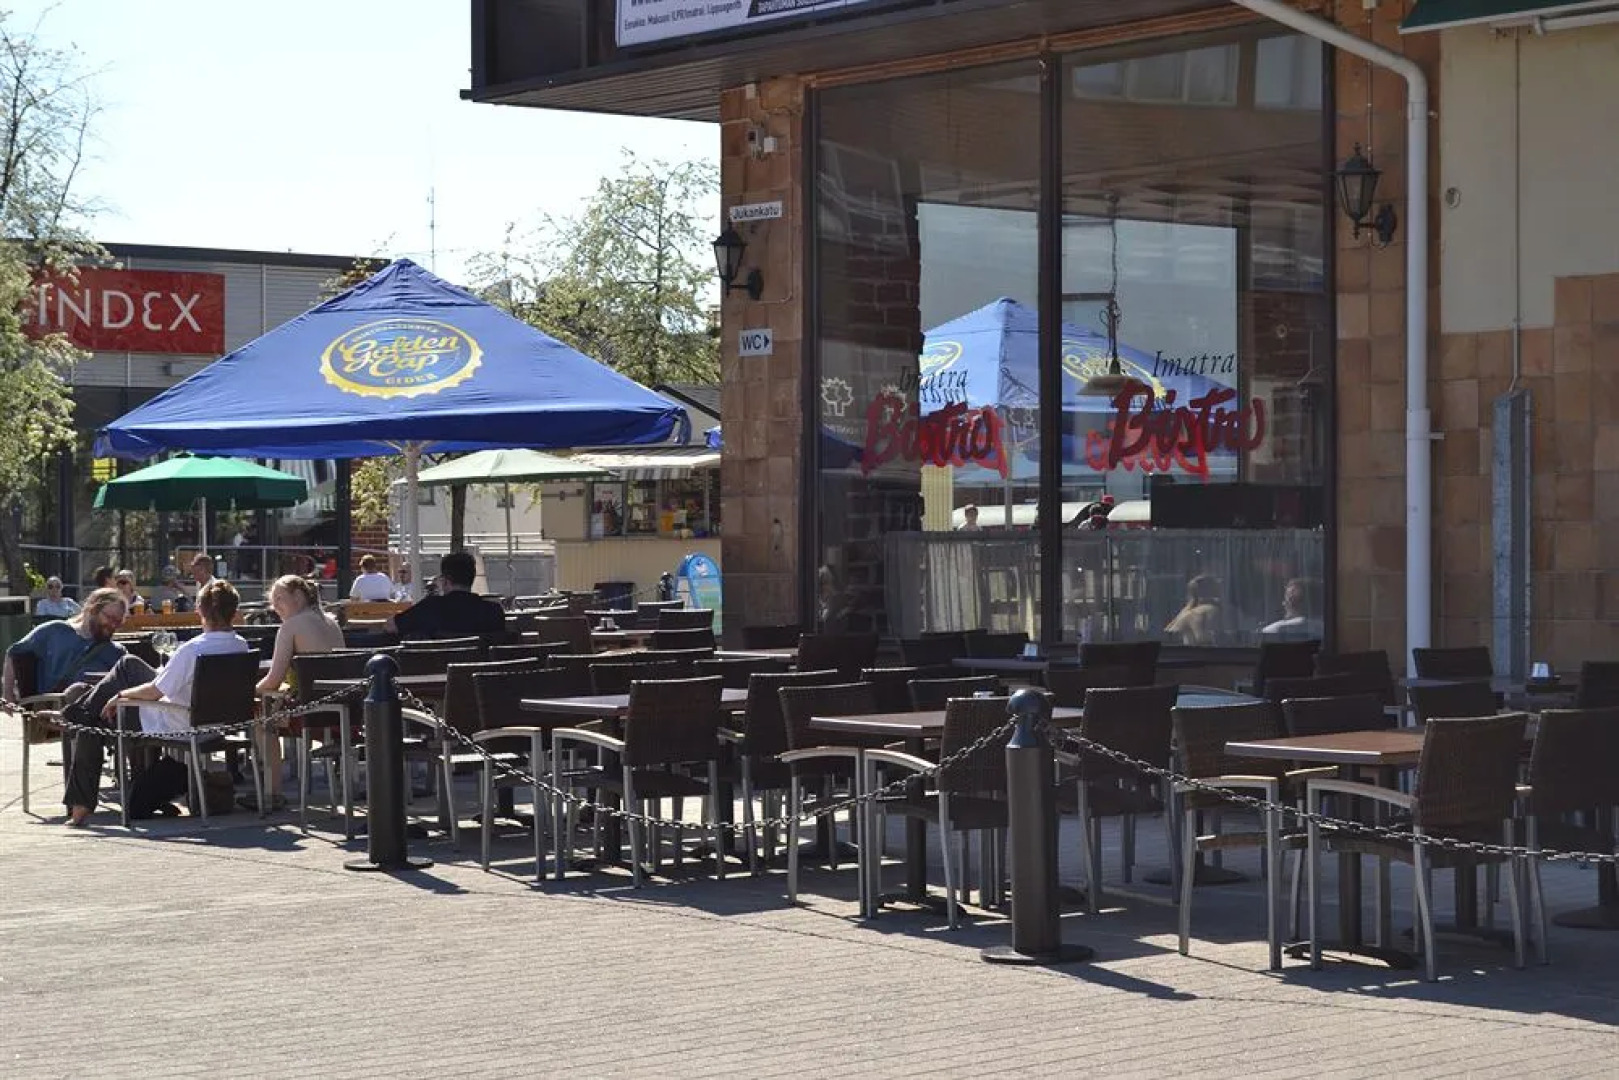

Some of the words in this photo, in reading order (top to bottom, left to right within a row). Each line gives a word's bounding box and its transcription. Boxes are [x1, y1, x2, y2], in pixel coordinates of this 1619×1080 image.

[733, 206, 779, 219] Jukankatu
[23, 284, 203, 334] INDEX
[338, 335, 460, 373] Golden
[741, 334, 762, 351] WC
[368, 353, 440, 377] Cap
[1152, 350, 1237, 378] Imatra
[385, 373, 439, 385] CIDER
[860, 388, 996, 478] Bistro
[1108, 378, 1265, 472] Bistro
